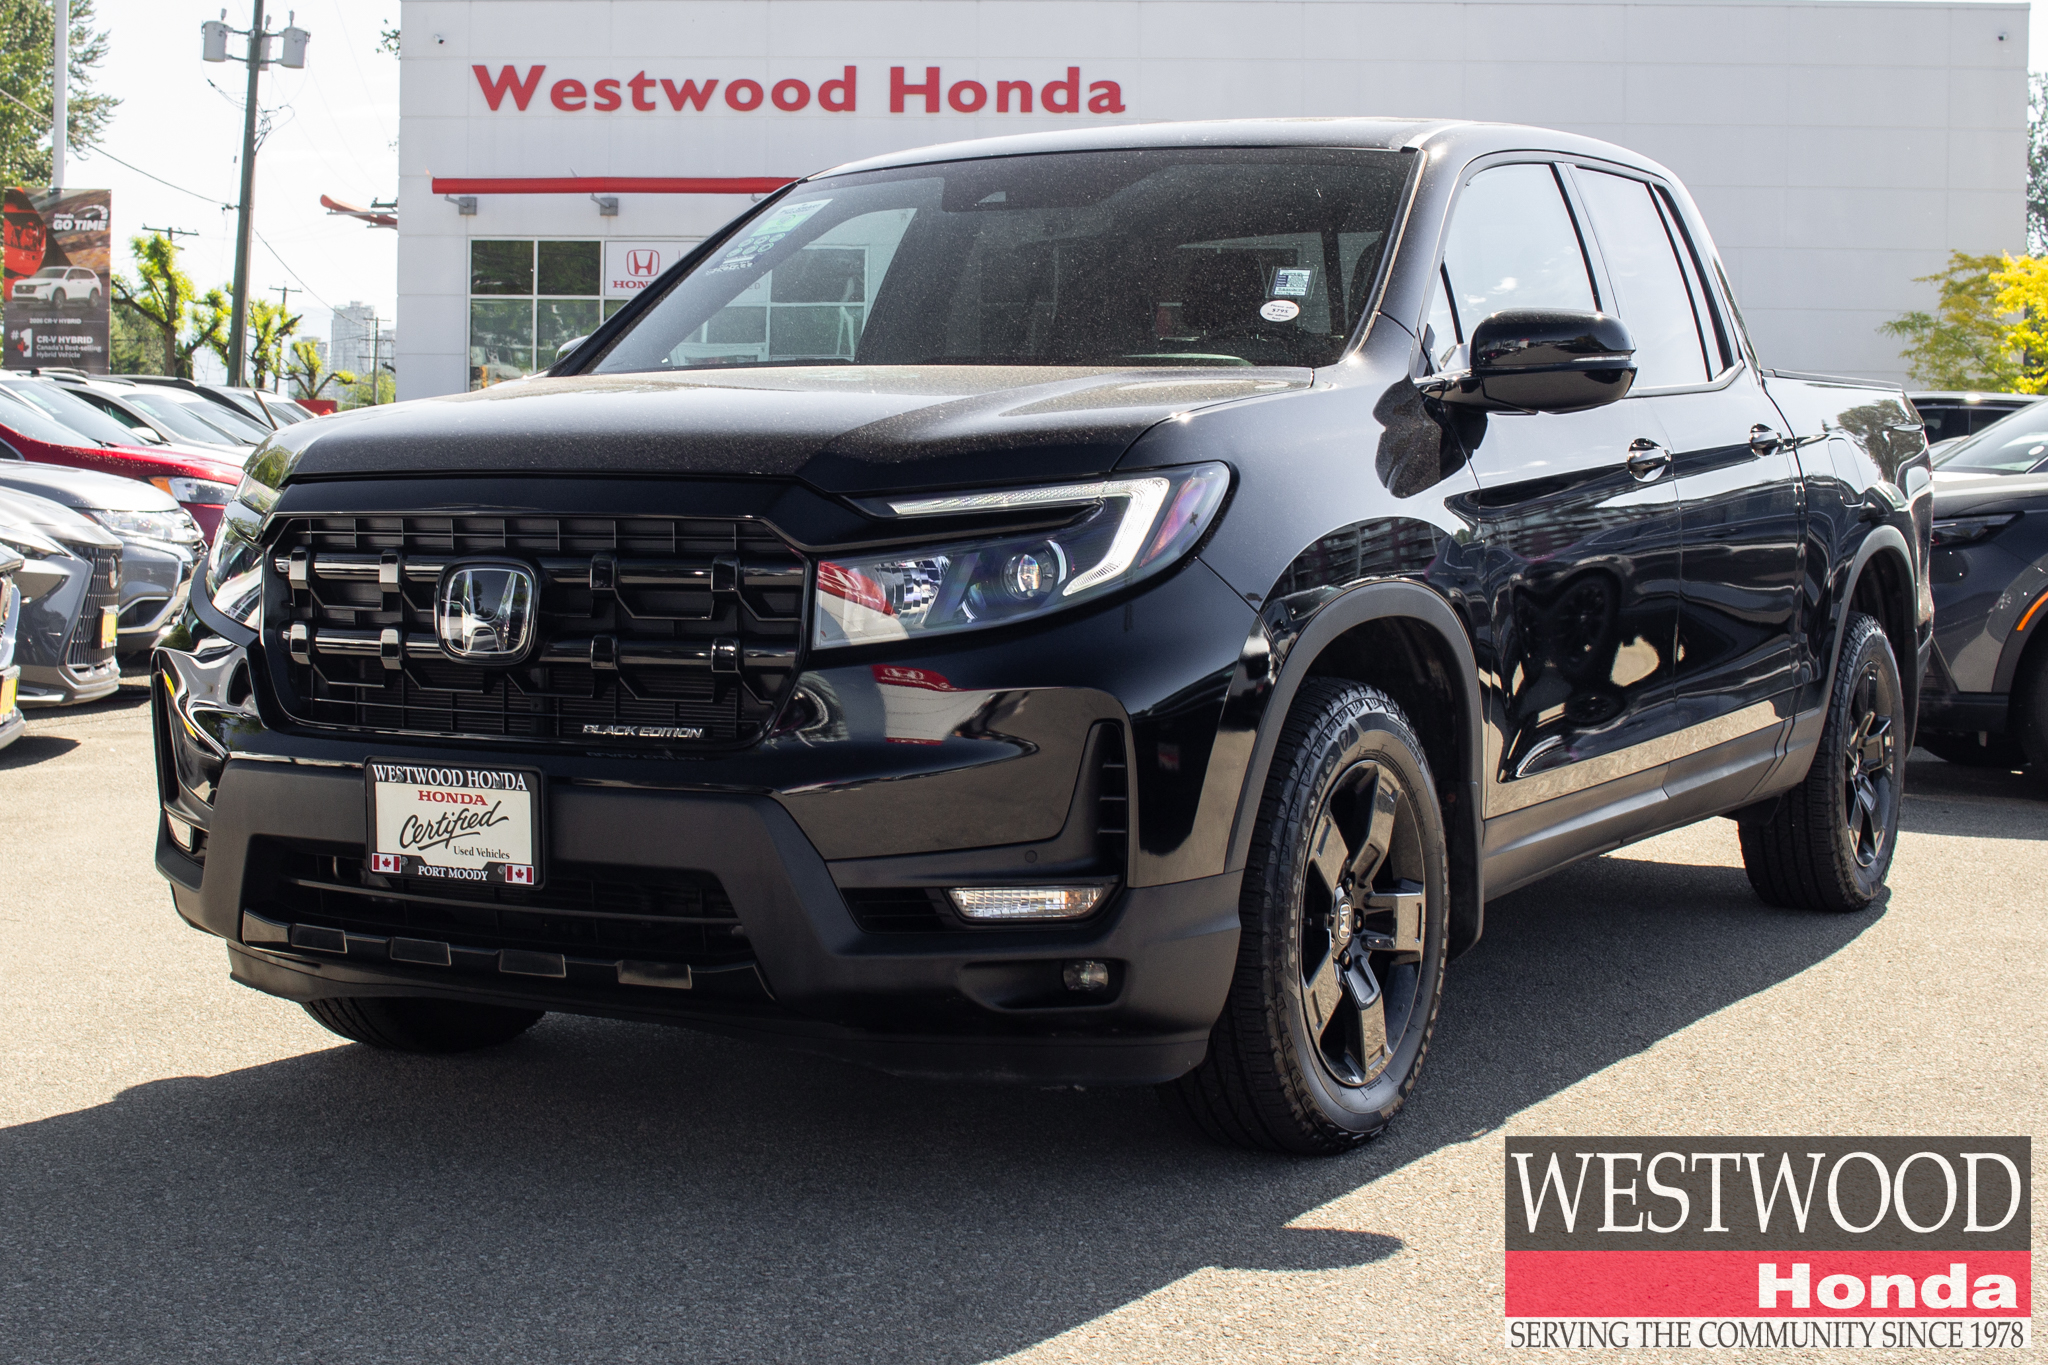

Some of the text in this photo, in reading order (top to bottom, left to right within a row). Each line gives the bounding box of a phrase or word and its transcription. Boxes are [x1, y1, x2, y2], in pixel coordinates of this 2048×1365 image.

[471, 64, 1126, 114] Westwood Honda
[53, 220, 108, 231] GO TIME
[613, 280, 652, 289] HON
[36, 336, 94, 344] CR-V HYBRID
[65, 345, 102, 353] Best-selling
[582, 724, 704, 738] BLACK EDITION
[372, 764, 527, 791] WESTWOOD HONDA
[417, 790, 488, 806] HONDA
[399, 800, 510, 851] Certified
[453, 846, 510, 860] Used Vehicles
[417, 865, 489, 881] PORT MOODY
